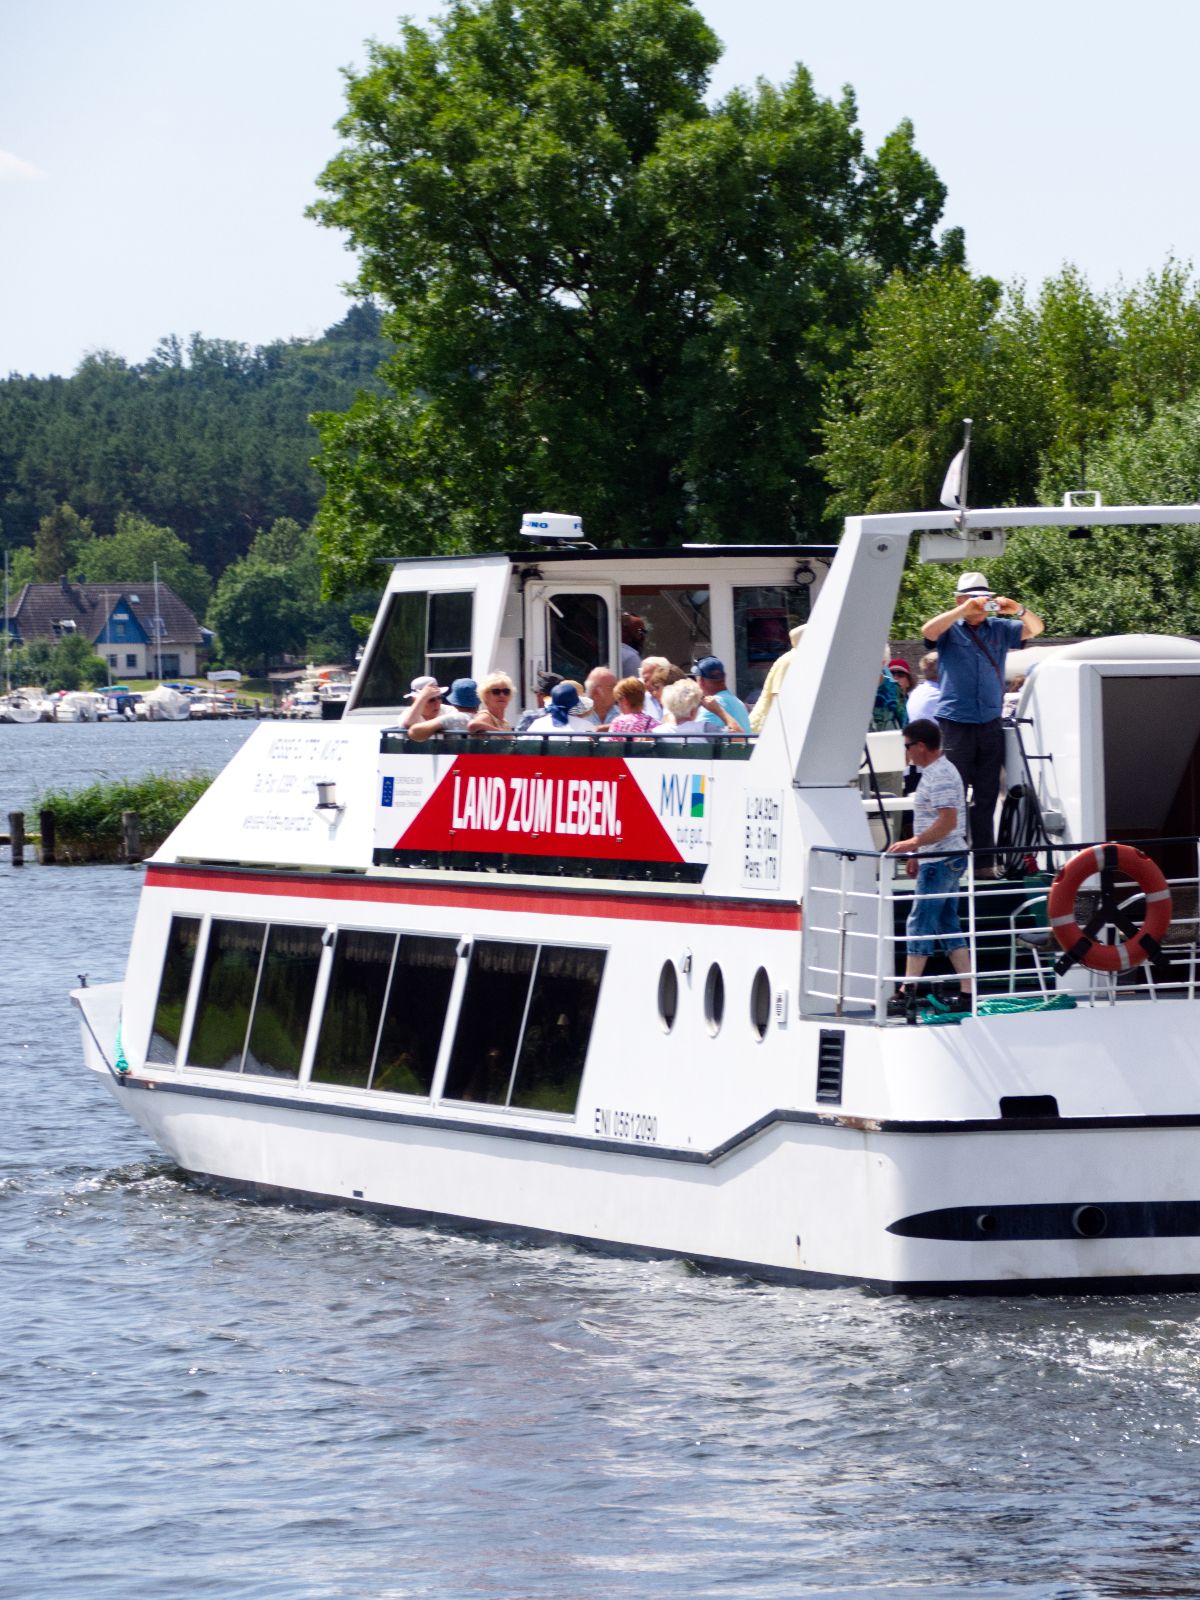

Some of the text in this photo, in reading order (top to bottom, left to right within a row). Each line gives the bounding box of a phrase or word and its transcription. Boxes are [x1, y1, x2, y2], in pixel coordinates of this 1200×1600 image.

[452, 776, 622, 837] LAND ZUM LEBEN.
[660, 773, 689, 817] MV
